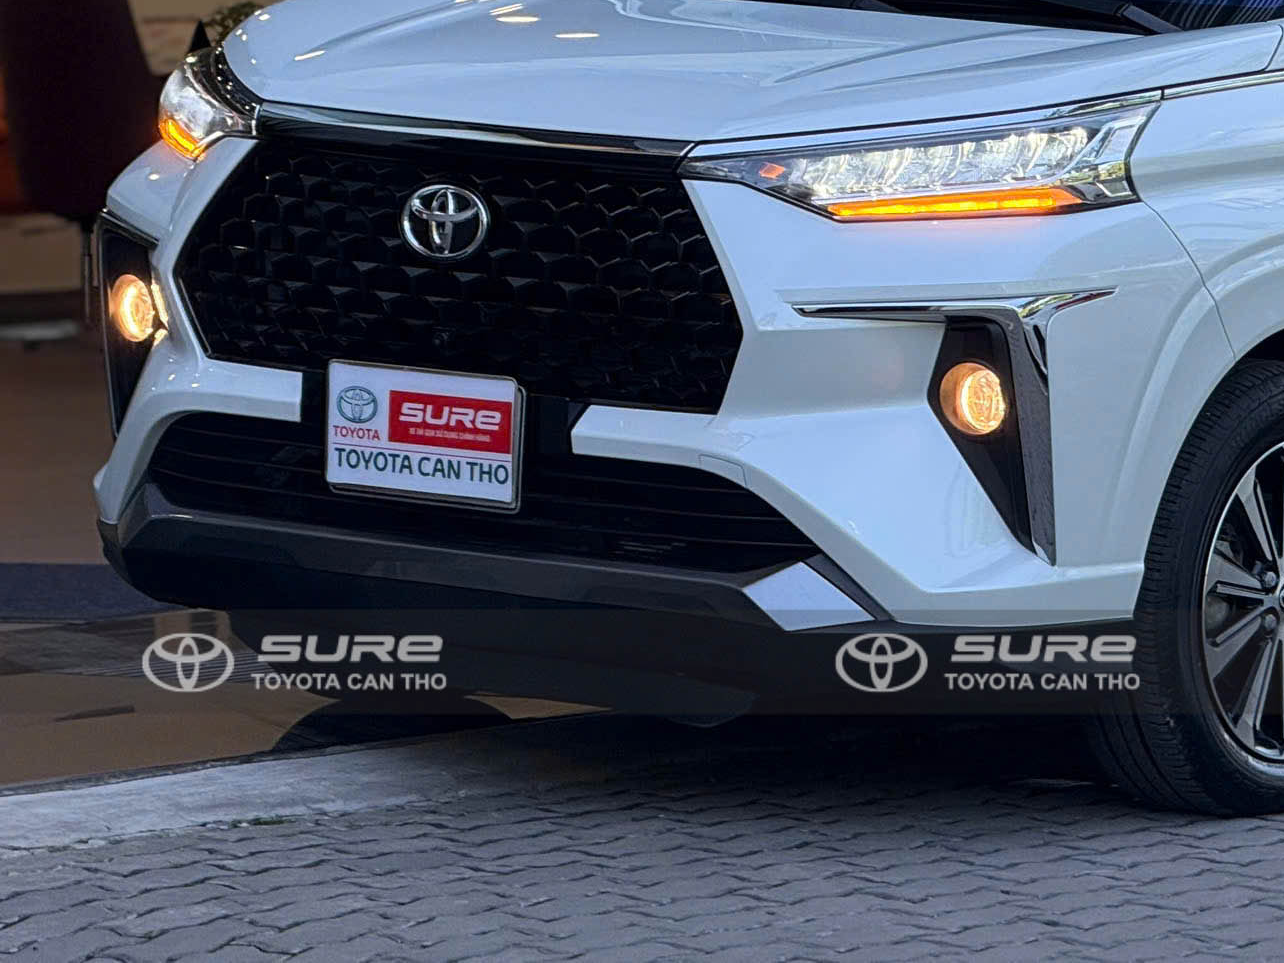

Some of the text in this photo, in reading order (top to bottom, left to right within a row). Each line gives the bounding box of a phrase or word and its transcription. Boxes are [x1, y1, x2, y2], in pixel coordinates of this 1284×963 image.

[332, 424, 382, 442] TOYOTA
[334, 447, 510, 485] TOYOTA CAN THO
